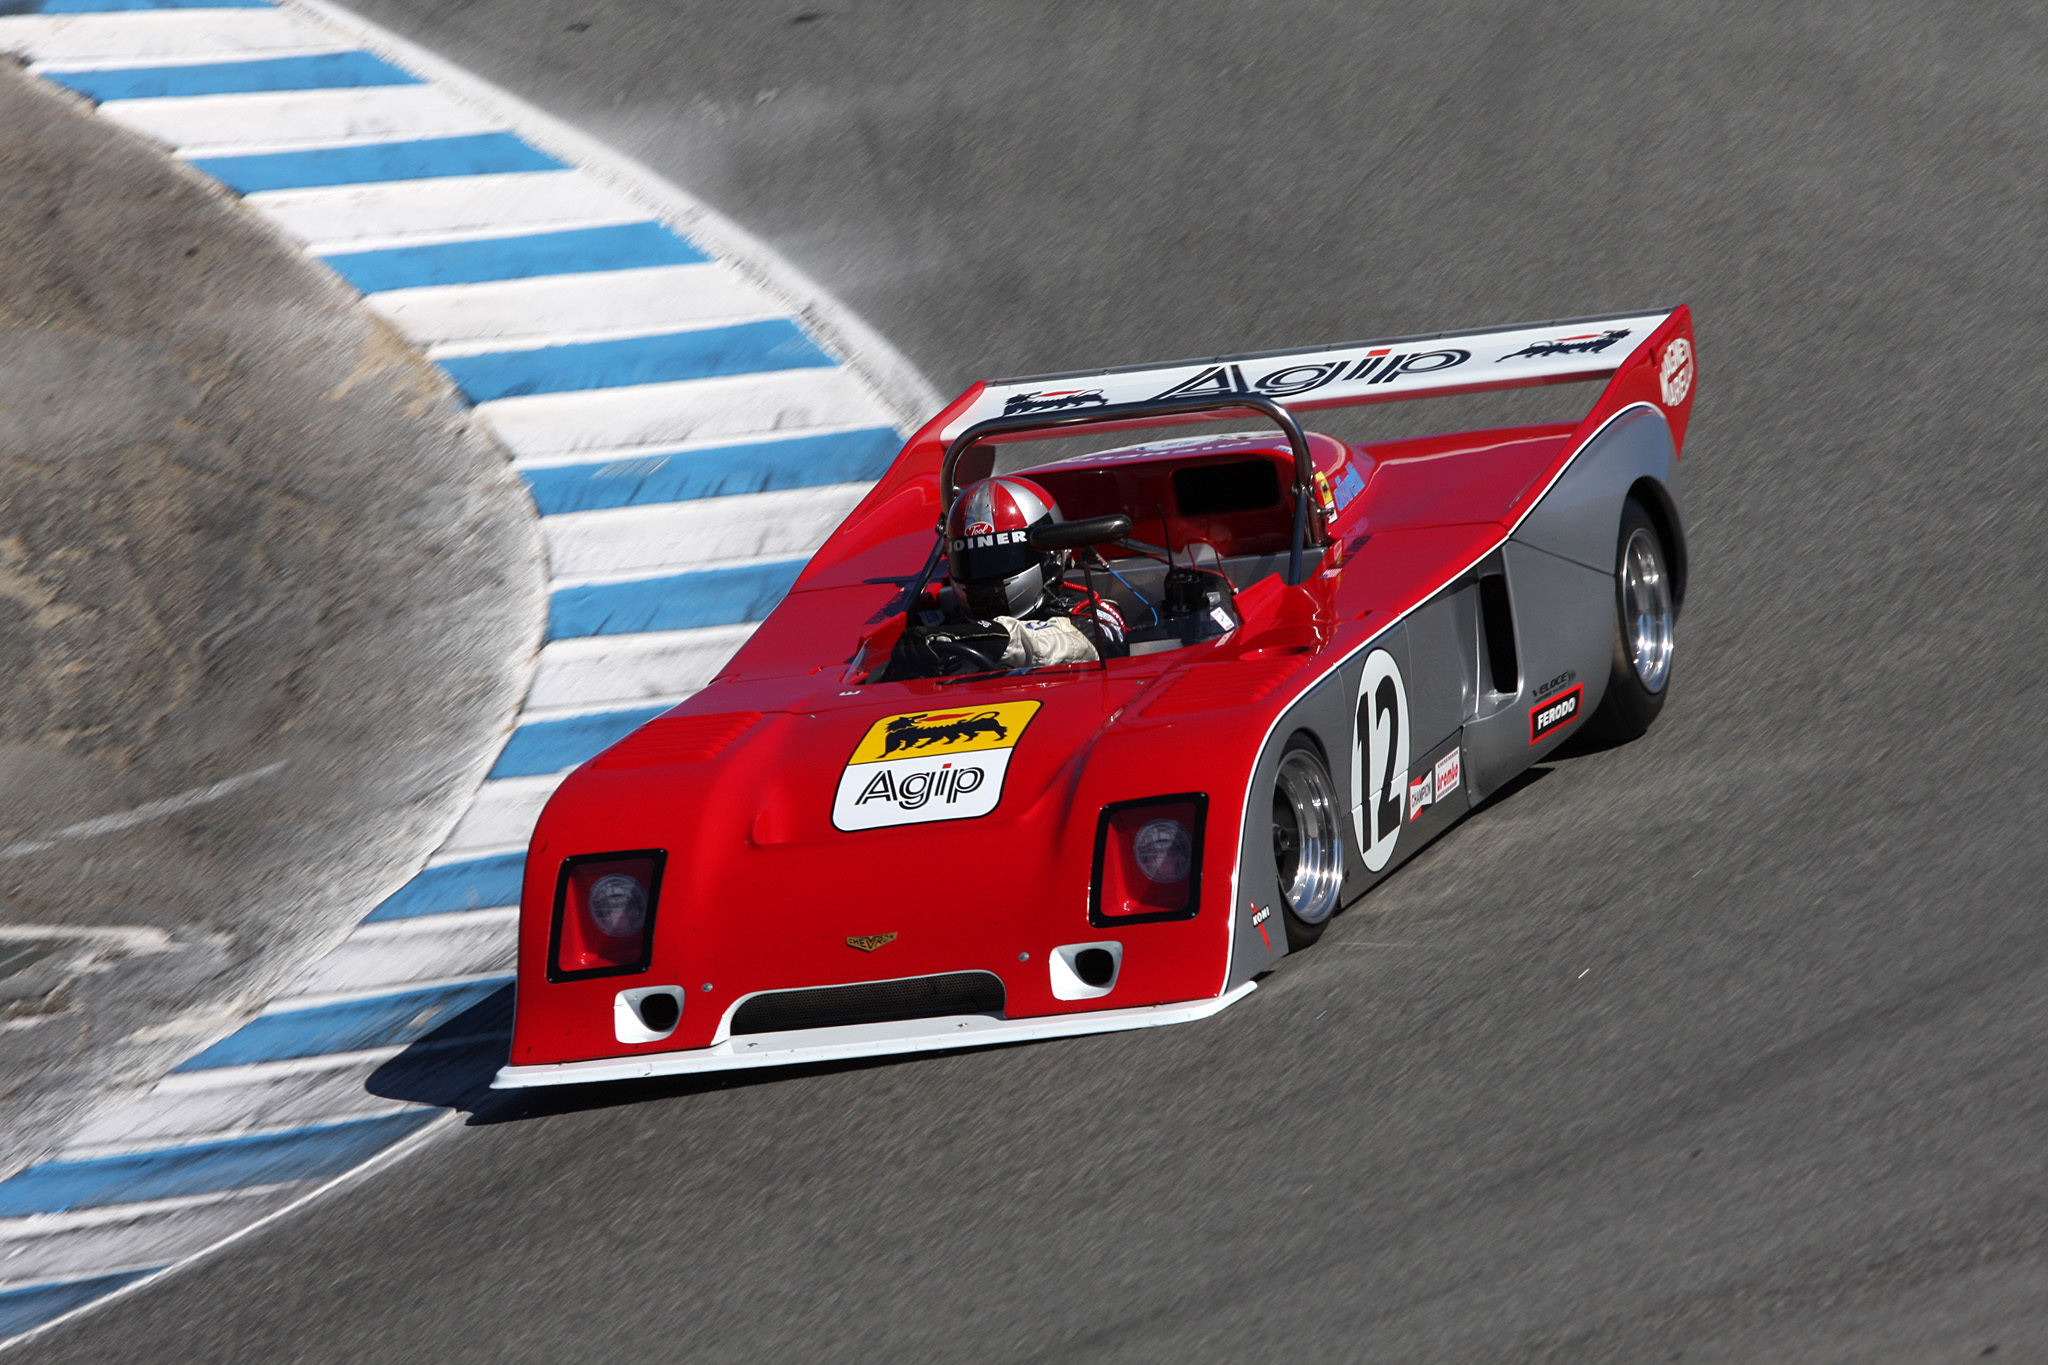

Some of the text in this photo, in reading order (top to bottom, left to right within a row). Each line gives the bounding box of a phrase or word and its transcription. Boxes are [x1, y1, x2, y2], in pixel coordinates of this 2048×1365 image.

[1145, 348, 1471, 400] Agip
[948, 531, 1028, 553] JOINER
[1532, 671, 1568, 697] VELOCE
[1537, 697, 1576, 730] FERODO
[1356, 675, 1401, 855] 12
[854, 763, 985, 810] Agip
[1411, 781, 1431, 808] CHAMPION
[1252, 906, 1270, 926] KONI
